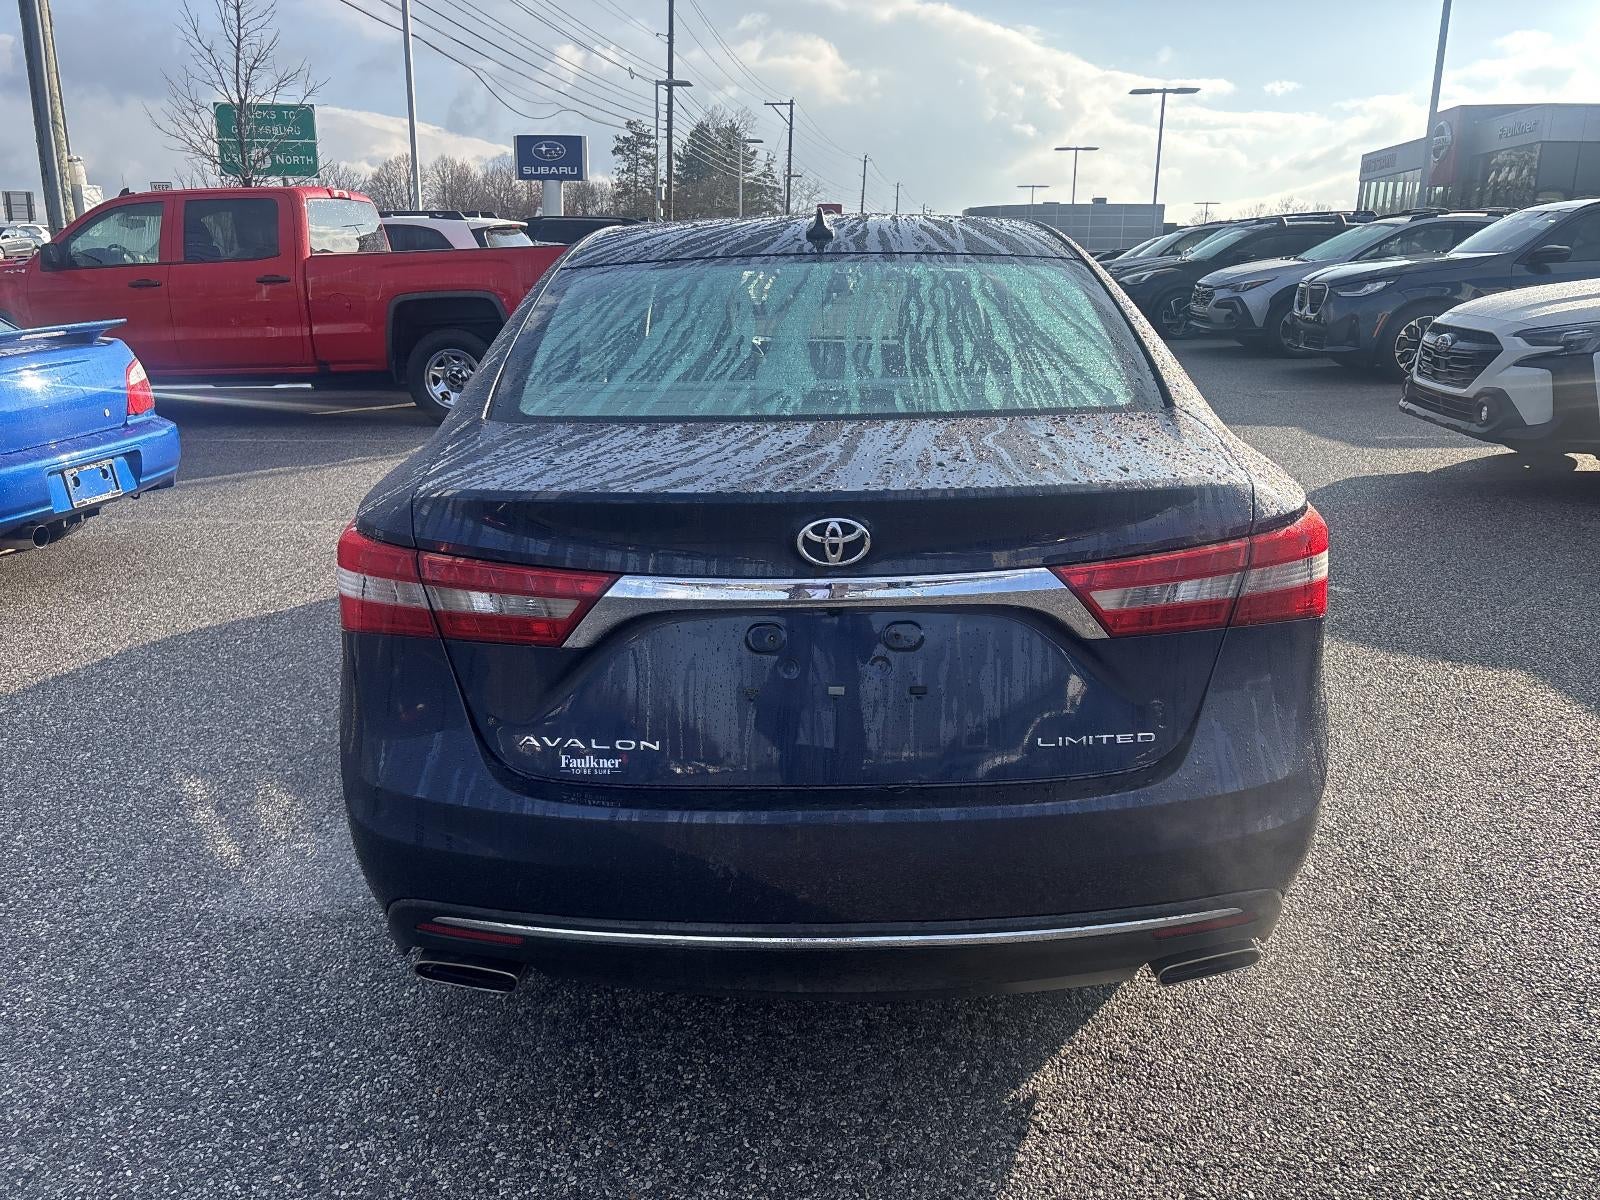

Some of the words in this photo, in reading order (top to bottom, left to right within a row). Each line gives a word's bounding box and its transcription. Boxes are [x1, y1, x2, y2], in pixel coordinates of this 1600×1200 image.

[282, 111, 296, 119] TO
[1498, 119, 1537, 139] Faulkner
[276, 155, 314, 165] NORTH
[522, 166, 578, 174] SUBARU
[519, 736, 660, 751] AVALON
[1037, 732, 1156, 747] LIMITED
[560, 754, 622, 768] Faulkner
